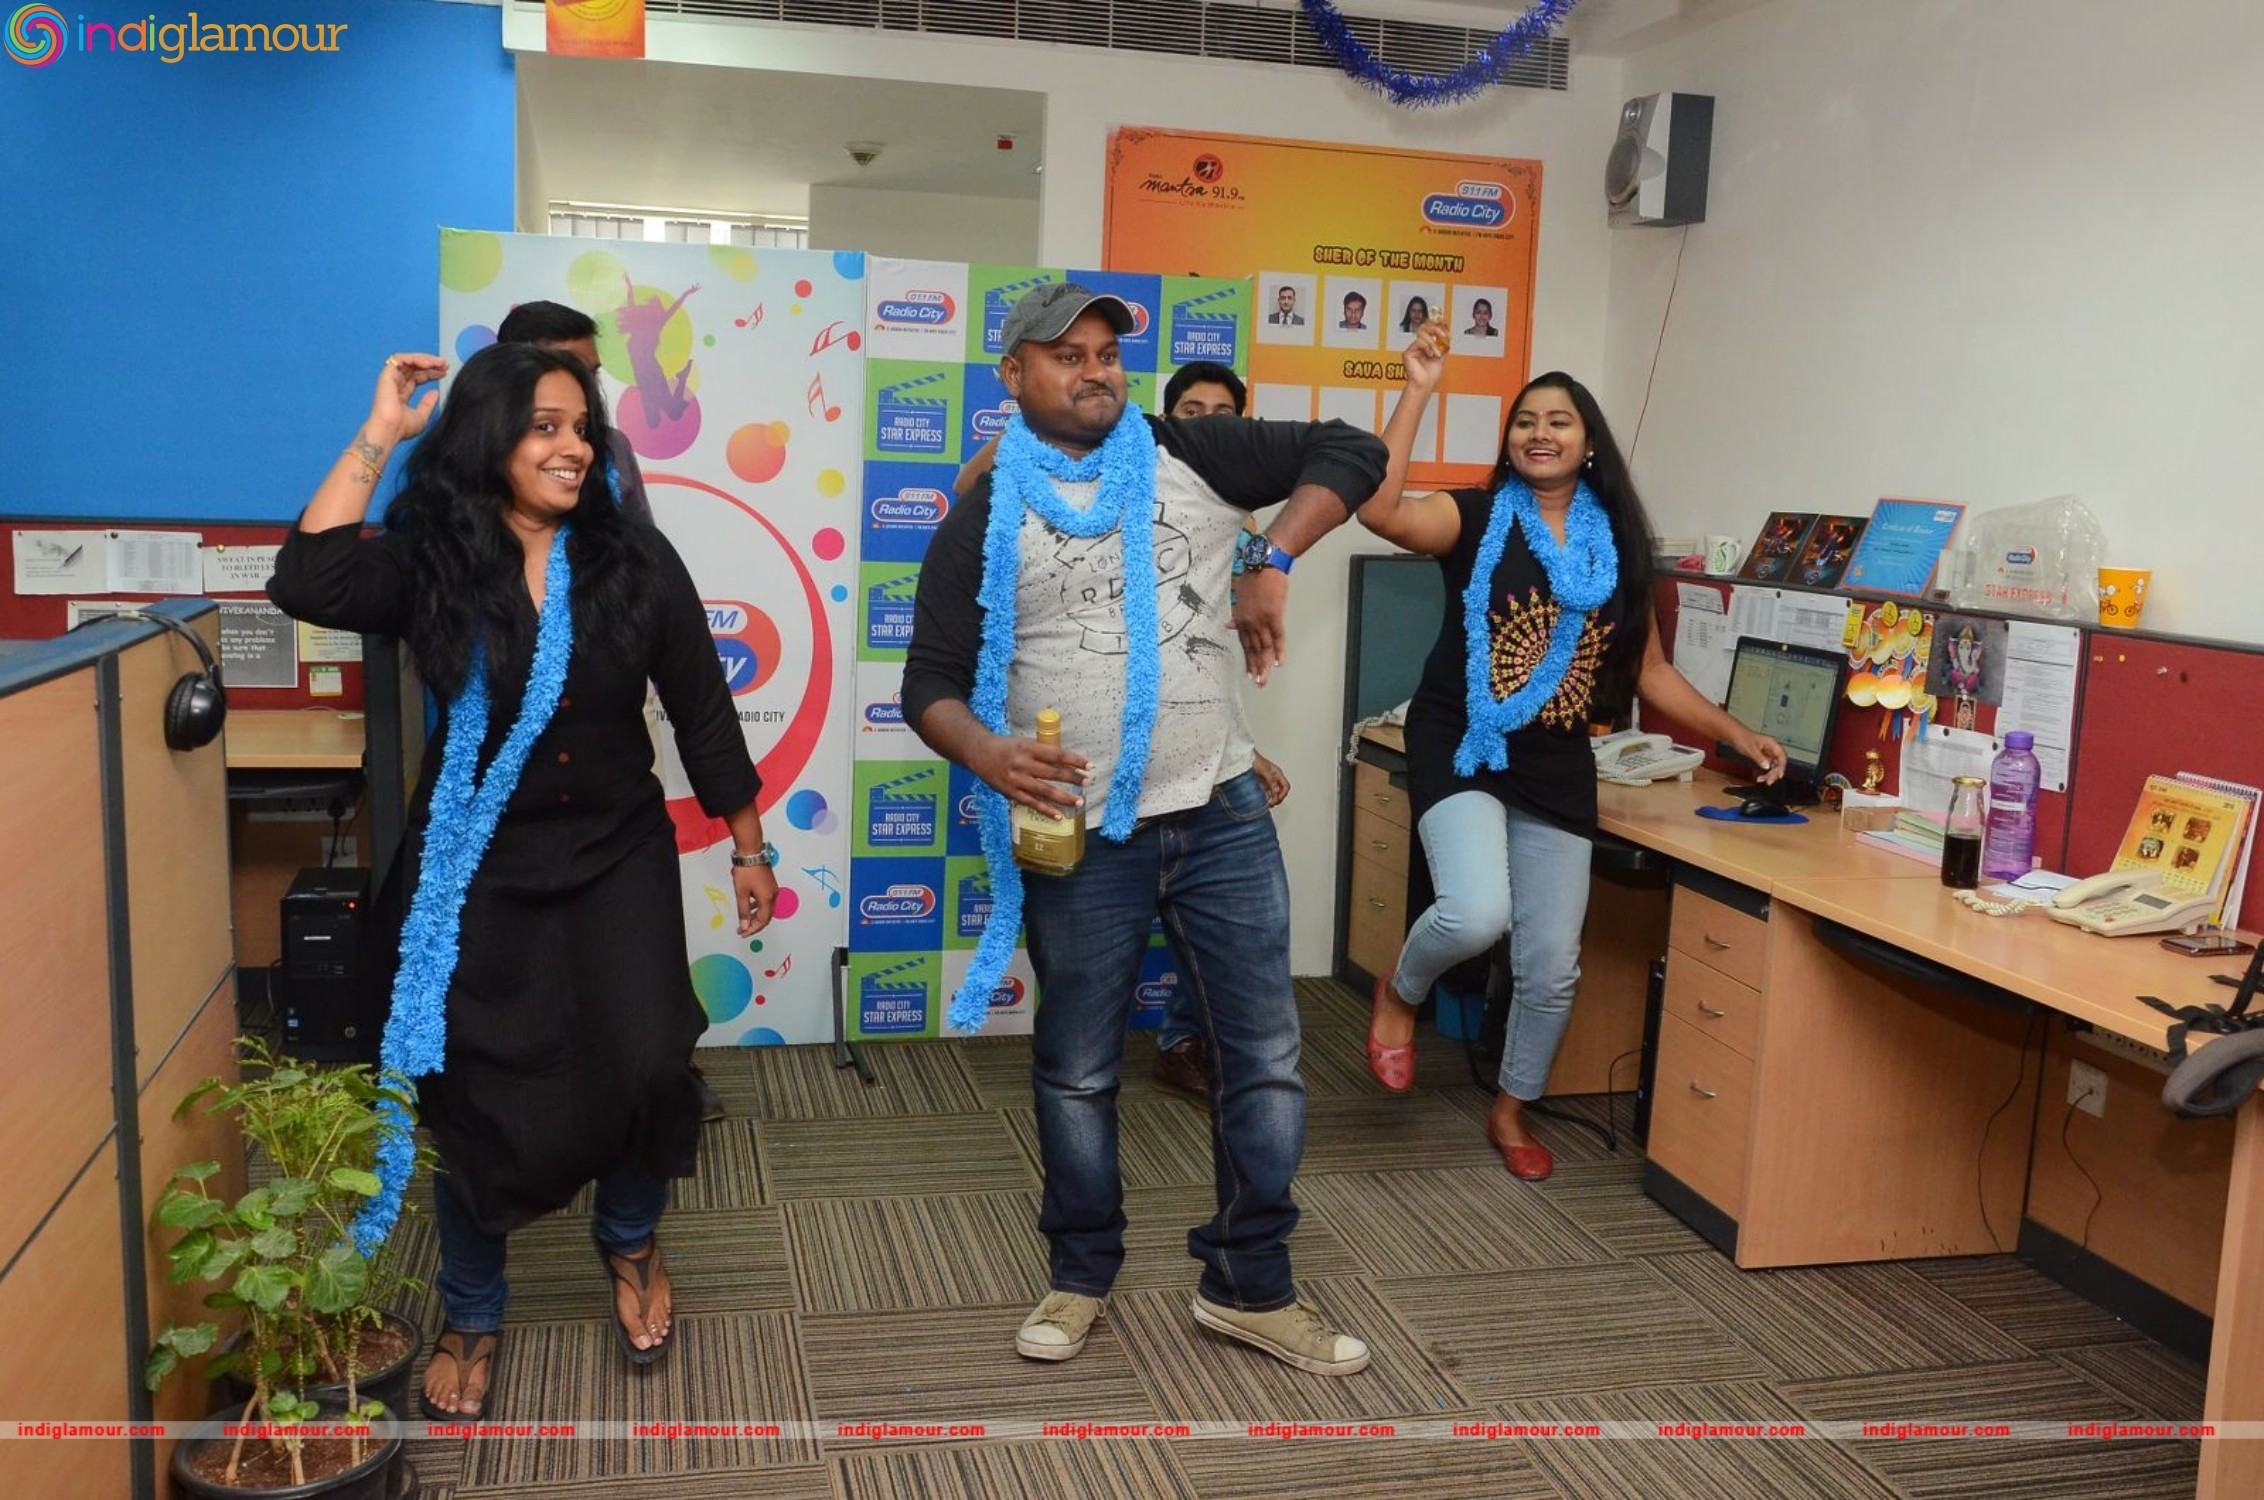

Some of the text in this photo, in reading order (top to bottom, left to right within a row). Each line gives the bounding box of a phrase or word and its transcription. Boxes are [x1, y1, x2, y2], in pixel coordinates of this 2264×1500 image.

[1212, 186, 1239, 199] 91.9
[1430, 200, 1501, 225] Radio City
[1313, 245, 1465, 273] SHER OF THE MONTH
[882, 305, 945, 324] Radio City
[1186, 331, 1220, 342] RADIO CITY
[1173, 341, 1232, 356] STAR EXPRESS
[1343, 360, 1382, 379] SAVA
[893, 417, 930, 428] RADIO CITY
[881, 427, 942, 443] STAR EXPRESS
[878, 504, 937, 520] Radio City
[871, 625, 894, 637] STAR
[763, 711, 786, 723] CITY
[885, 813, 920, 823] RADIO CITY
[871, 823, 932, 836] STAR EXPRESS
[867, 900, 923, 915] Radio City
[897, 1000, 910, 1010] CITY
[990, 991, 1014, 1005] City
[863, 1009, 923, 1023] STAR EXPRESS
